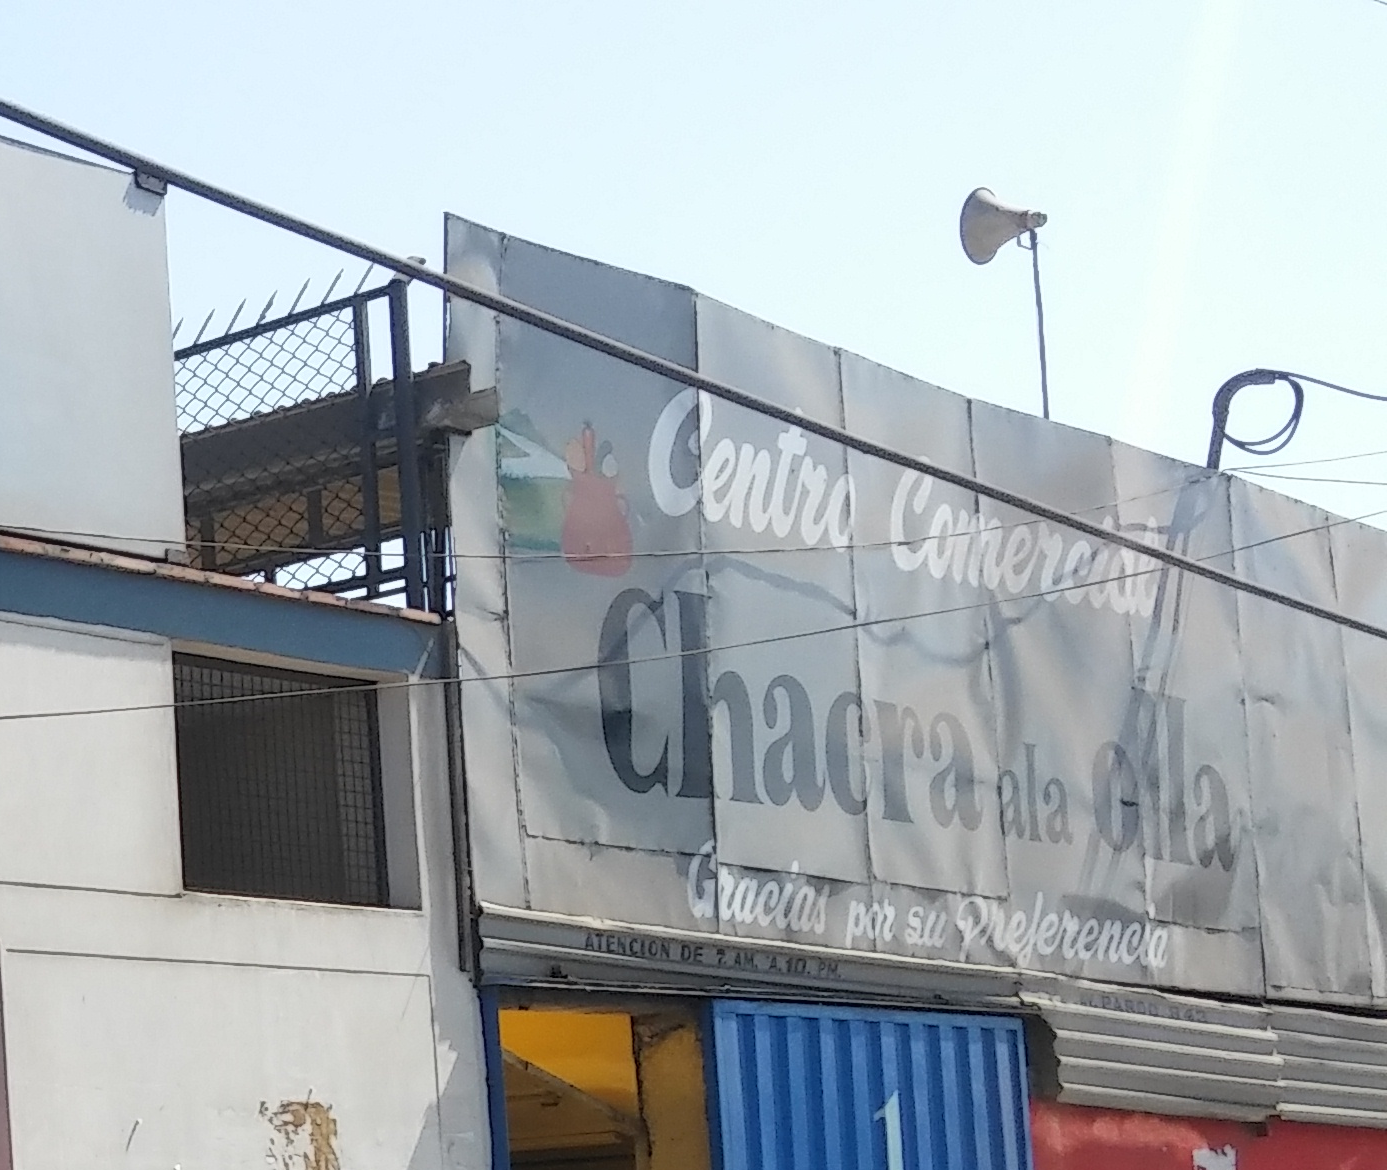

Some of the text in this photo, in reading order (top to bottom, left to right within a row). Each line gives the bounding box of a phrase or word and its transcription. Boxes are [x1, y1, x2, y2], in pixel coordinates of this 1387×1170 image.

[648, 387, 856, 552] Centro
[597, 588, 983, 832] Chacra
[584, 932, 671, 959] ATENCION
[680, 946, 704, 963] DE
[688, 842, 1169, 970] Gracias por su Preferencia
